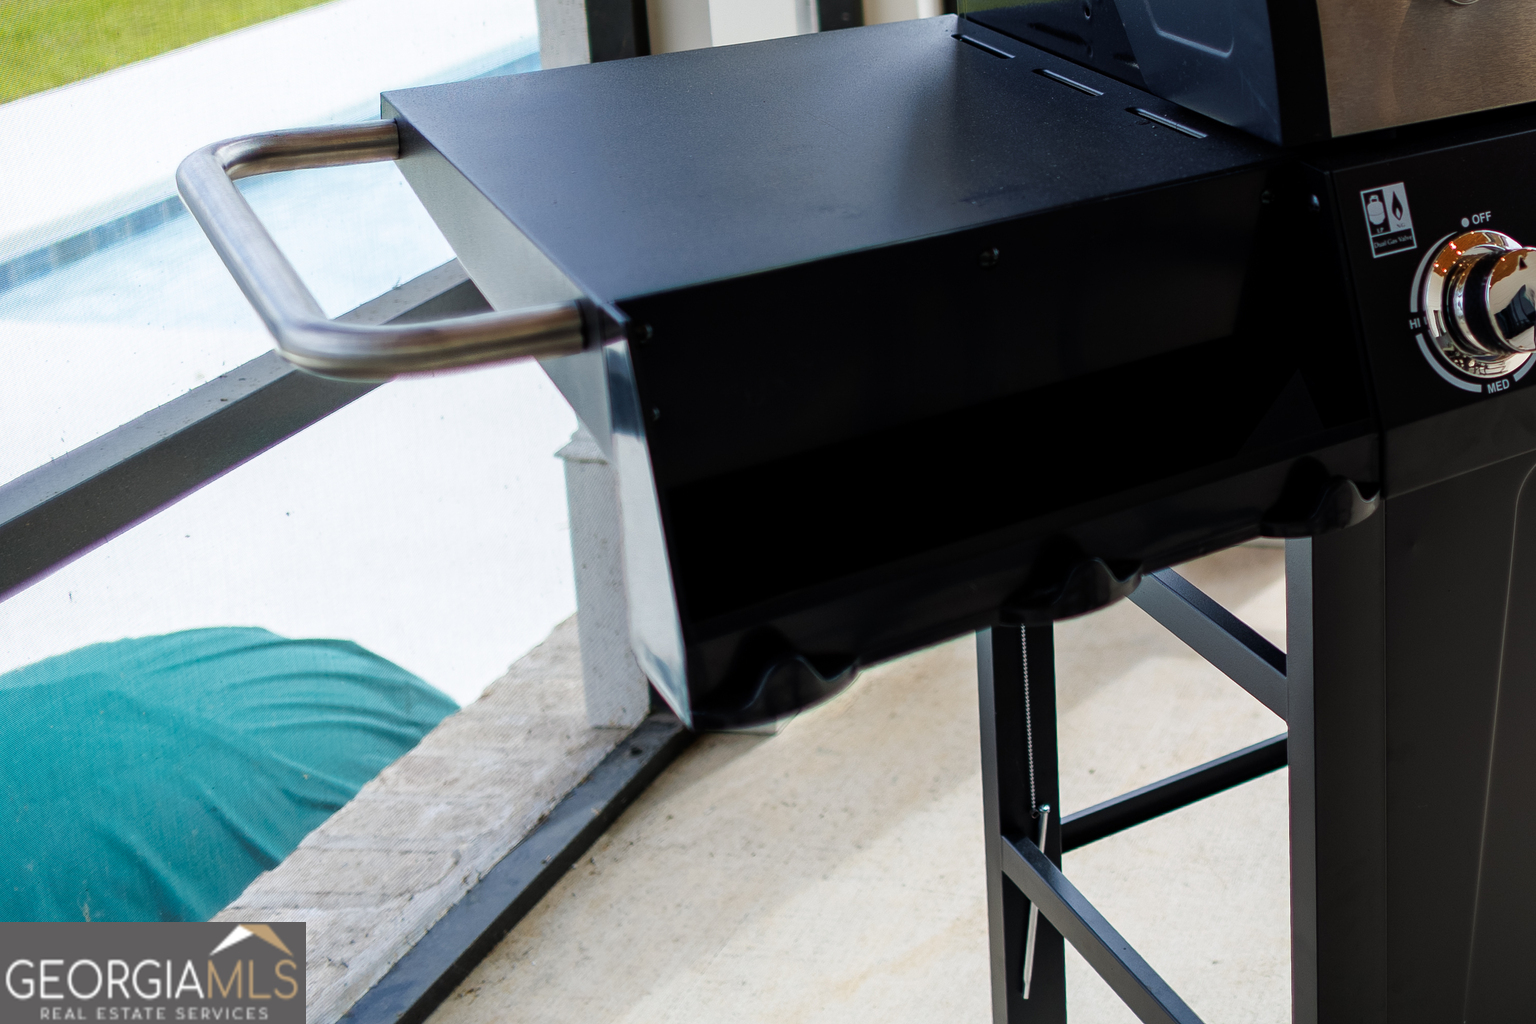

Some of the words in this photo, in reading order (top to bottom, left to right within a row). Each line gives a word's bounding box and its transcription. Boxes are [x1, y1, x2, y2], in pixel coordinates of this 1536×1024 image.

[1472, 211, 1492, 225] OFF
[1374, 240, 1387, 248] Dual
[1409, 318, 1421, 330] HI
[1487, 378, 1510, 394] MED
